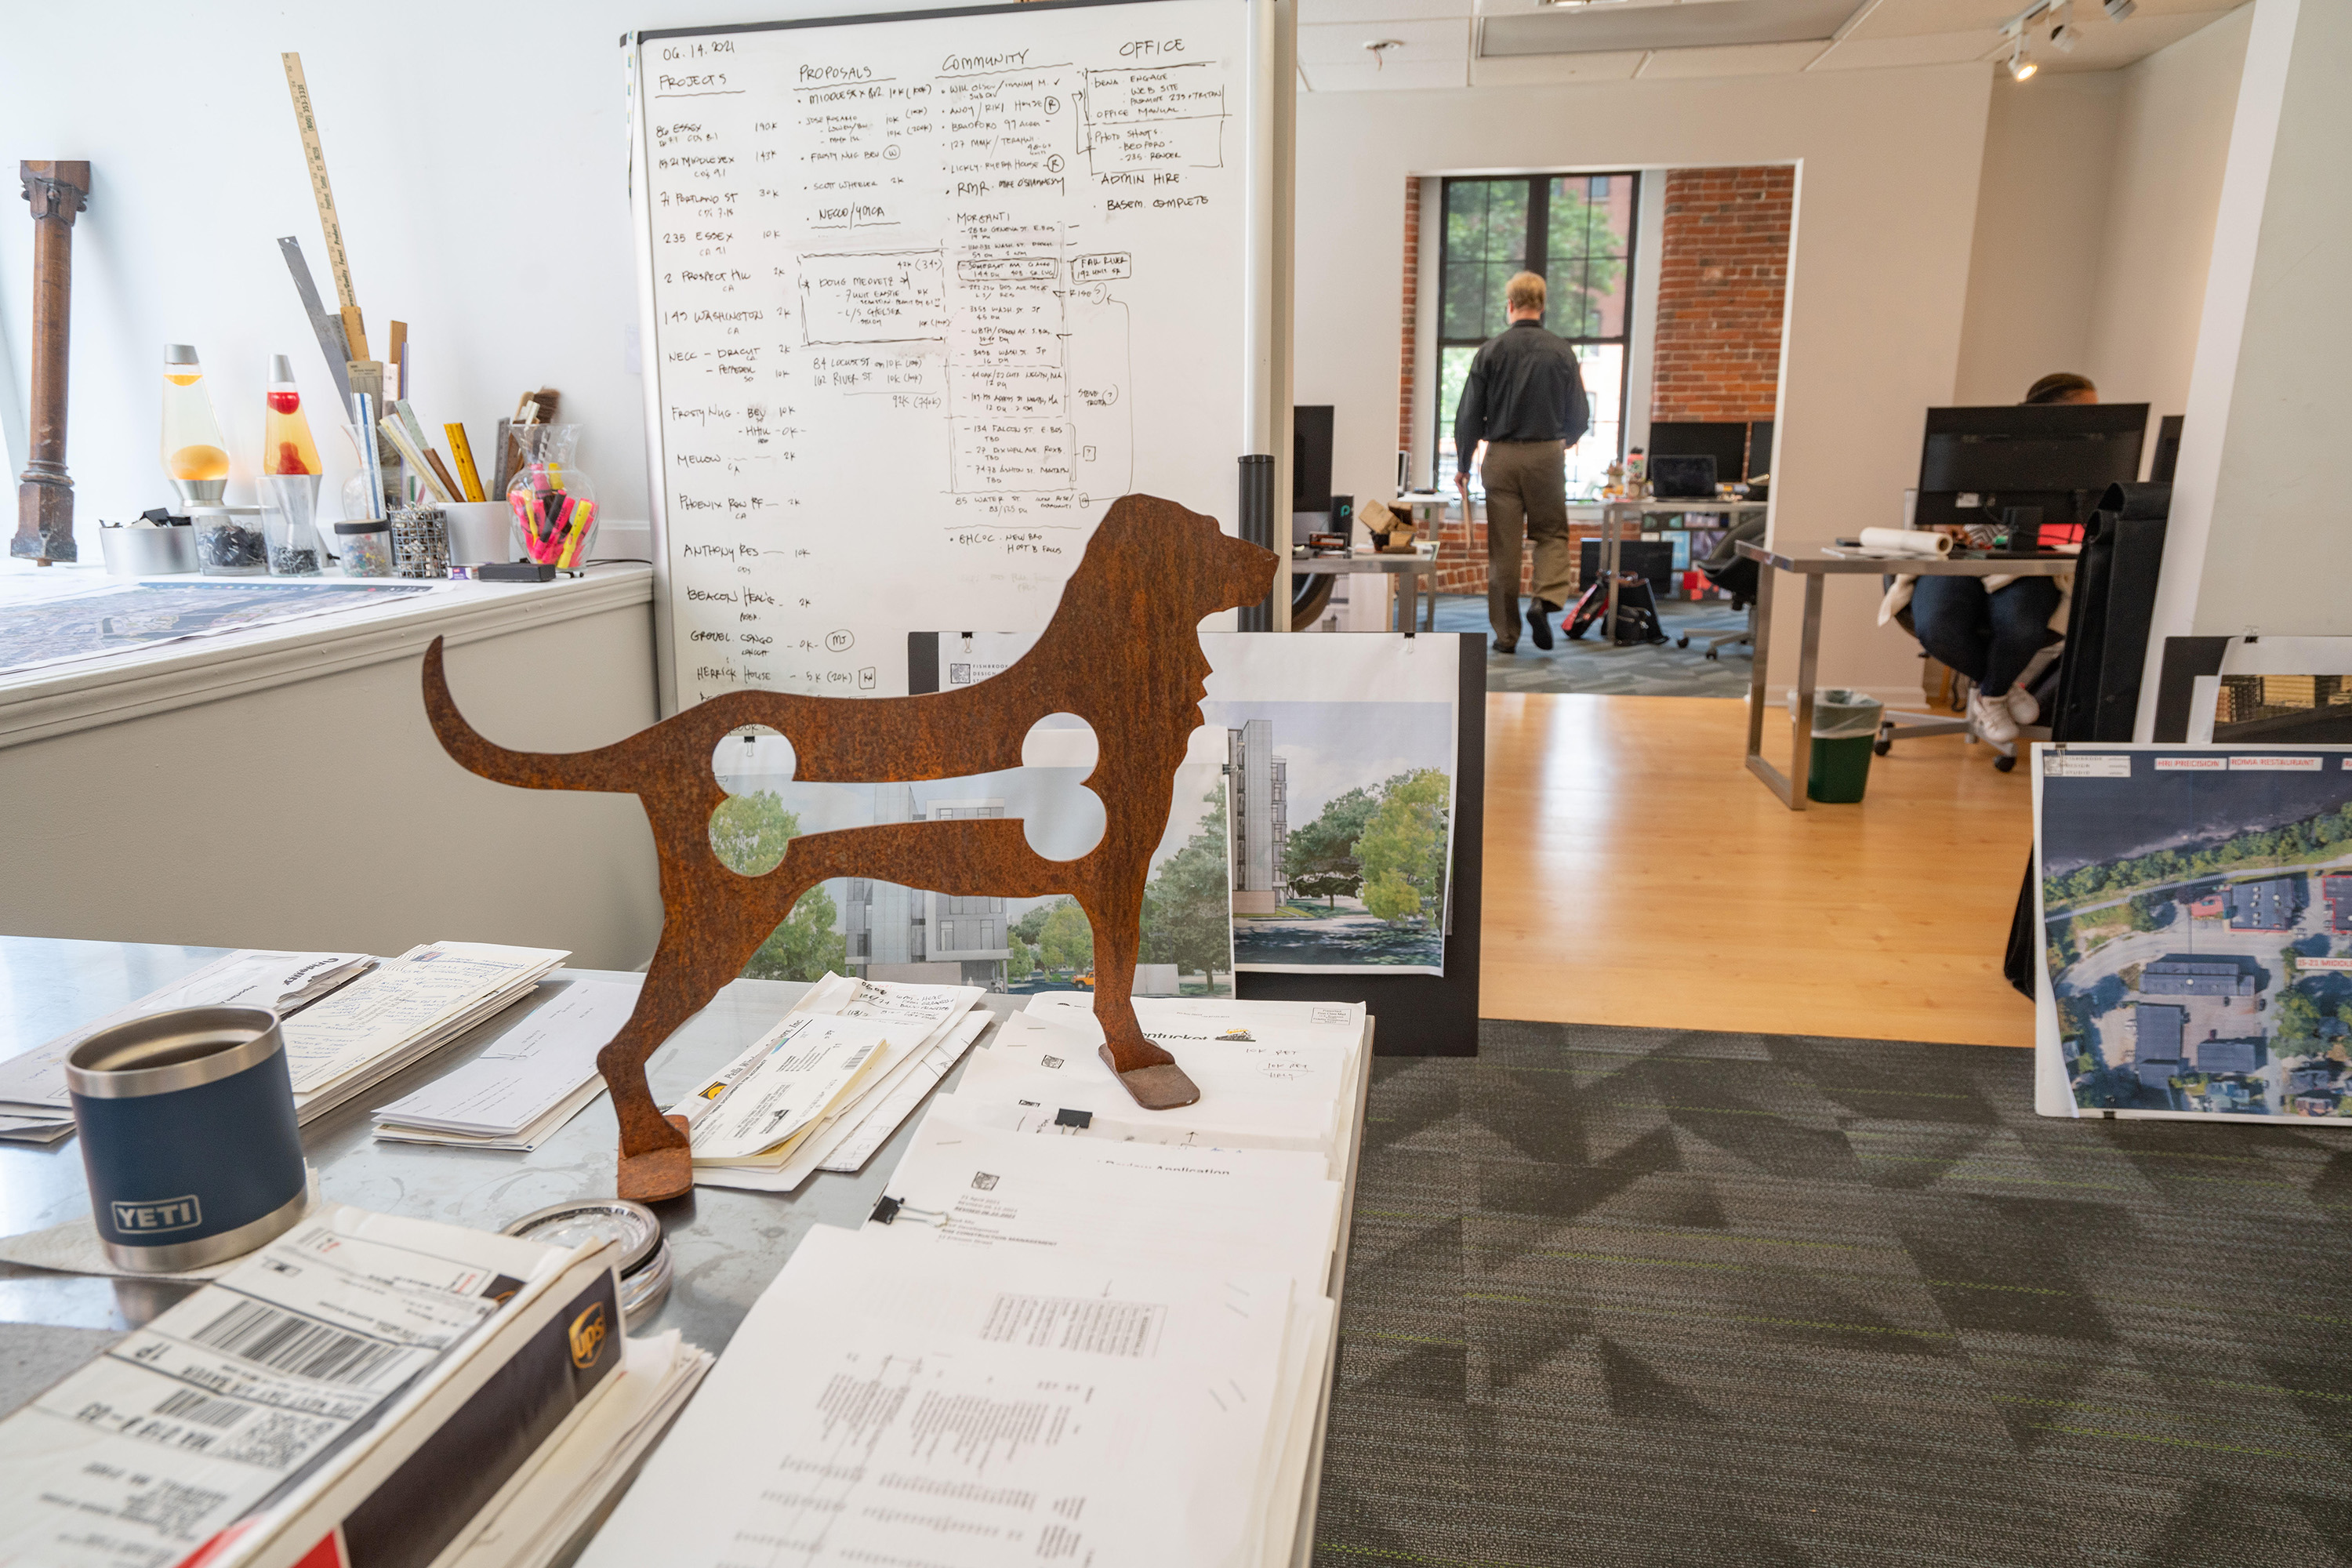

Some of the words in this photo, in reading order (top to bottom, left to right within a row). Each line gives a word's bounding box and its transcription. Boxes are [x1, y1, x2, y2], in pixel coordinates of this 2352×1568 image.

[1120, 39, 1185, 58] OFFICE
[942, 49, 1029, 71] COMMUNITY
[800, 64, 872, 82] PROPOSALS
[1130, 73, 1167, 82] ENGAGE
[659, 74, 727, 90] PROJECTS
[1160, 83, 1178, 93] SITE
[1097, 110, 1129, 118] OFFICE
[1138, 107, 1179, 117] MANUAL
[673, 124, 702, 133] ESSEX
[1101, 172, 1145, 186] ADMIN
[1154, 172, 1180, 185] HIRE
[957, 181, 989, 196] RMR
[676, 192, 719, 205] PORTLAND
[724, 193, 739, 202] ST
[1152, 195, 1209, 209] COMPLETE
[663, 233, 686, 243] 235
[695, 232, 733, 241] ESSEX
[819, 278, 846, 288] DOUG
[695, 310, 764, 322] WASHINGTON
[677, 454, 721, 466] MELLOW
[783, 452, 796, 461] 2K
[680, 493, 722, 510] PHOENIX
[684, 543, 735, 562] ANTHONY
[739, 543, 759, 557] RES
[795, 548, 811, 558] 10K
[687, 586, 738, 602] BEACON
[799, 598, 811, 608] 2K
[744, 665, 771, 684] HOUSE
[724, 1067, 743, 1080] Pella
[118, 1203, 191, 1228] YETI
[574, 1317, 604, 1359] ups
